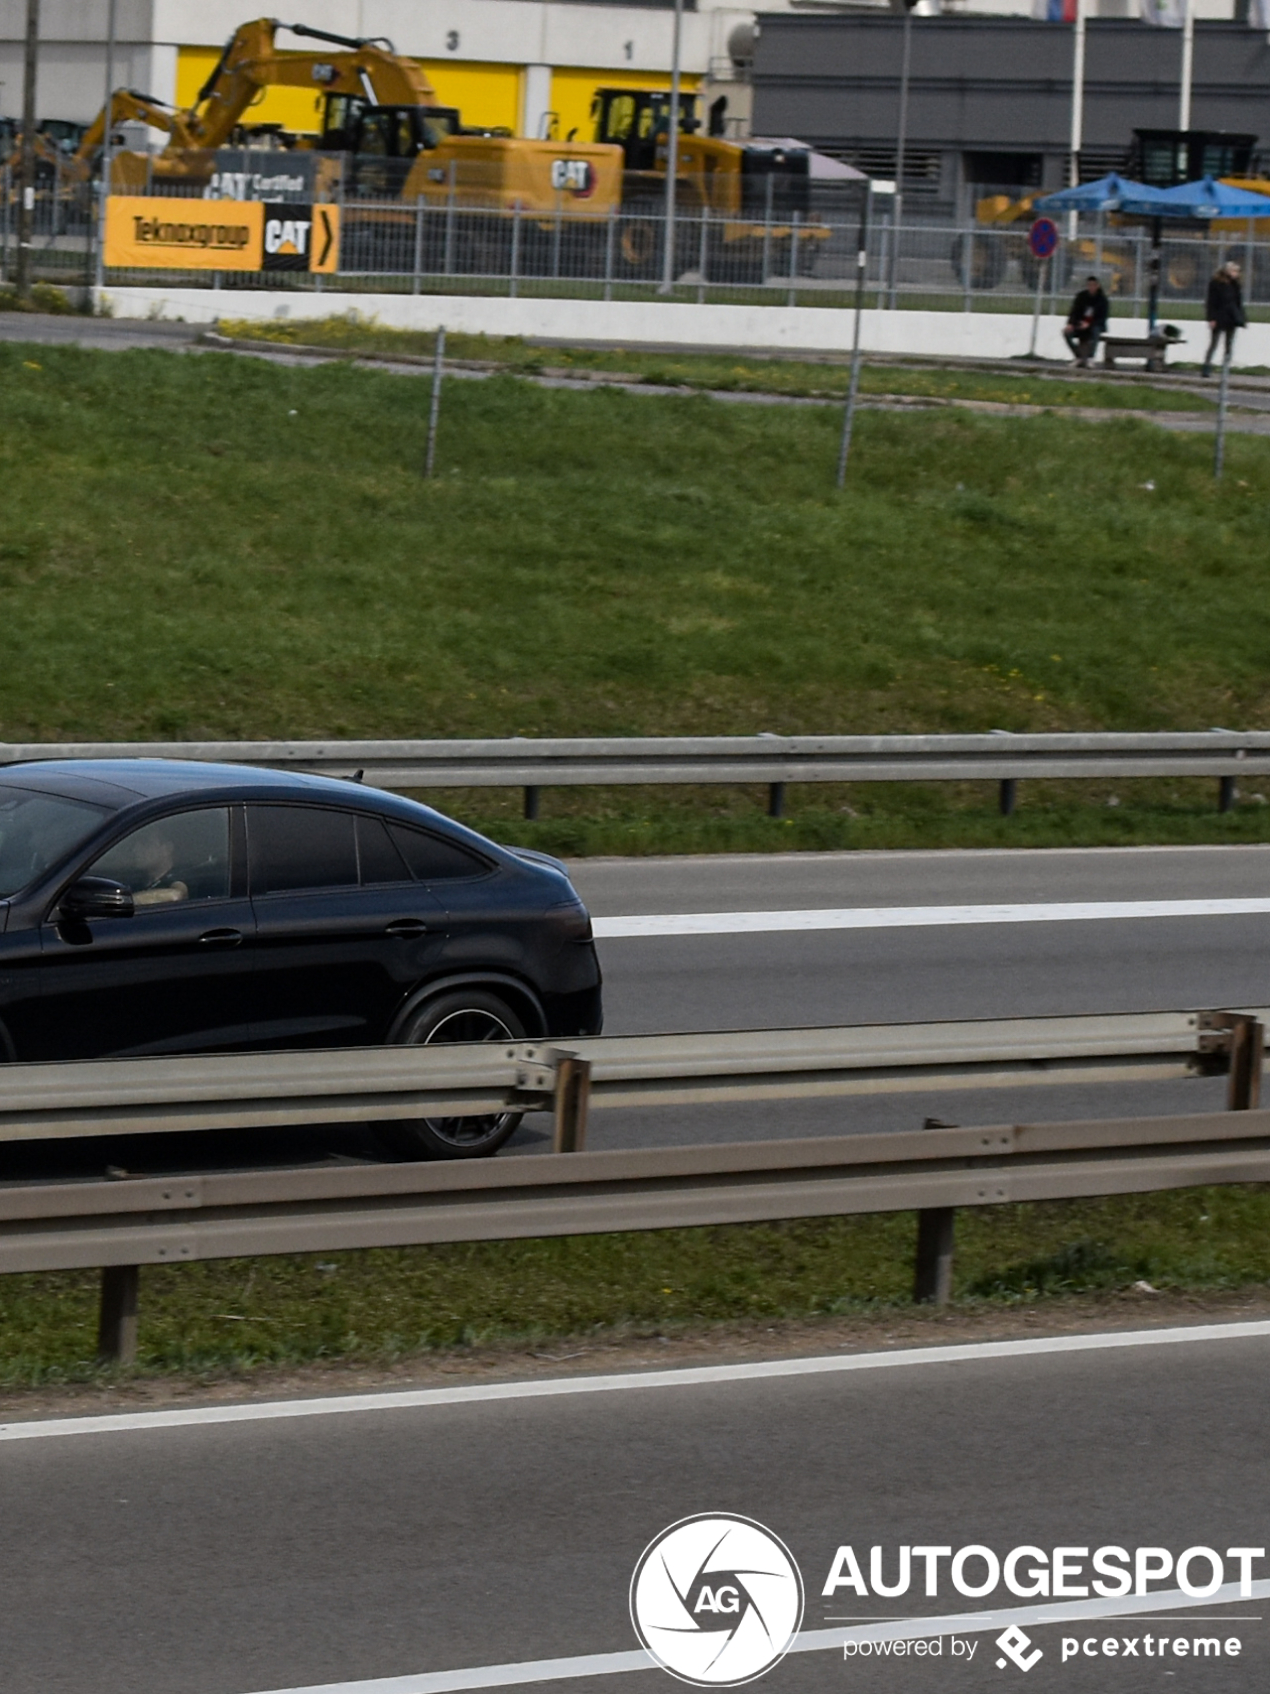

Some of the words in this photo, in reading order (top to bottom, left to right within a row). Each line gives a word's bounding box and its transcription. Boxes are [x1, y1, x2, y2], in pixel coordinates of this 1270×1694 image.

[445, 29, 460, 52] 3
[623, 40, 634, 61] 1
[551, 159, 588, 190] CAT
[133, 215, 250, 250] Teknoxgroup
[264, 219, 311, 254] CAT
